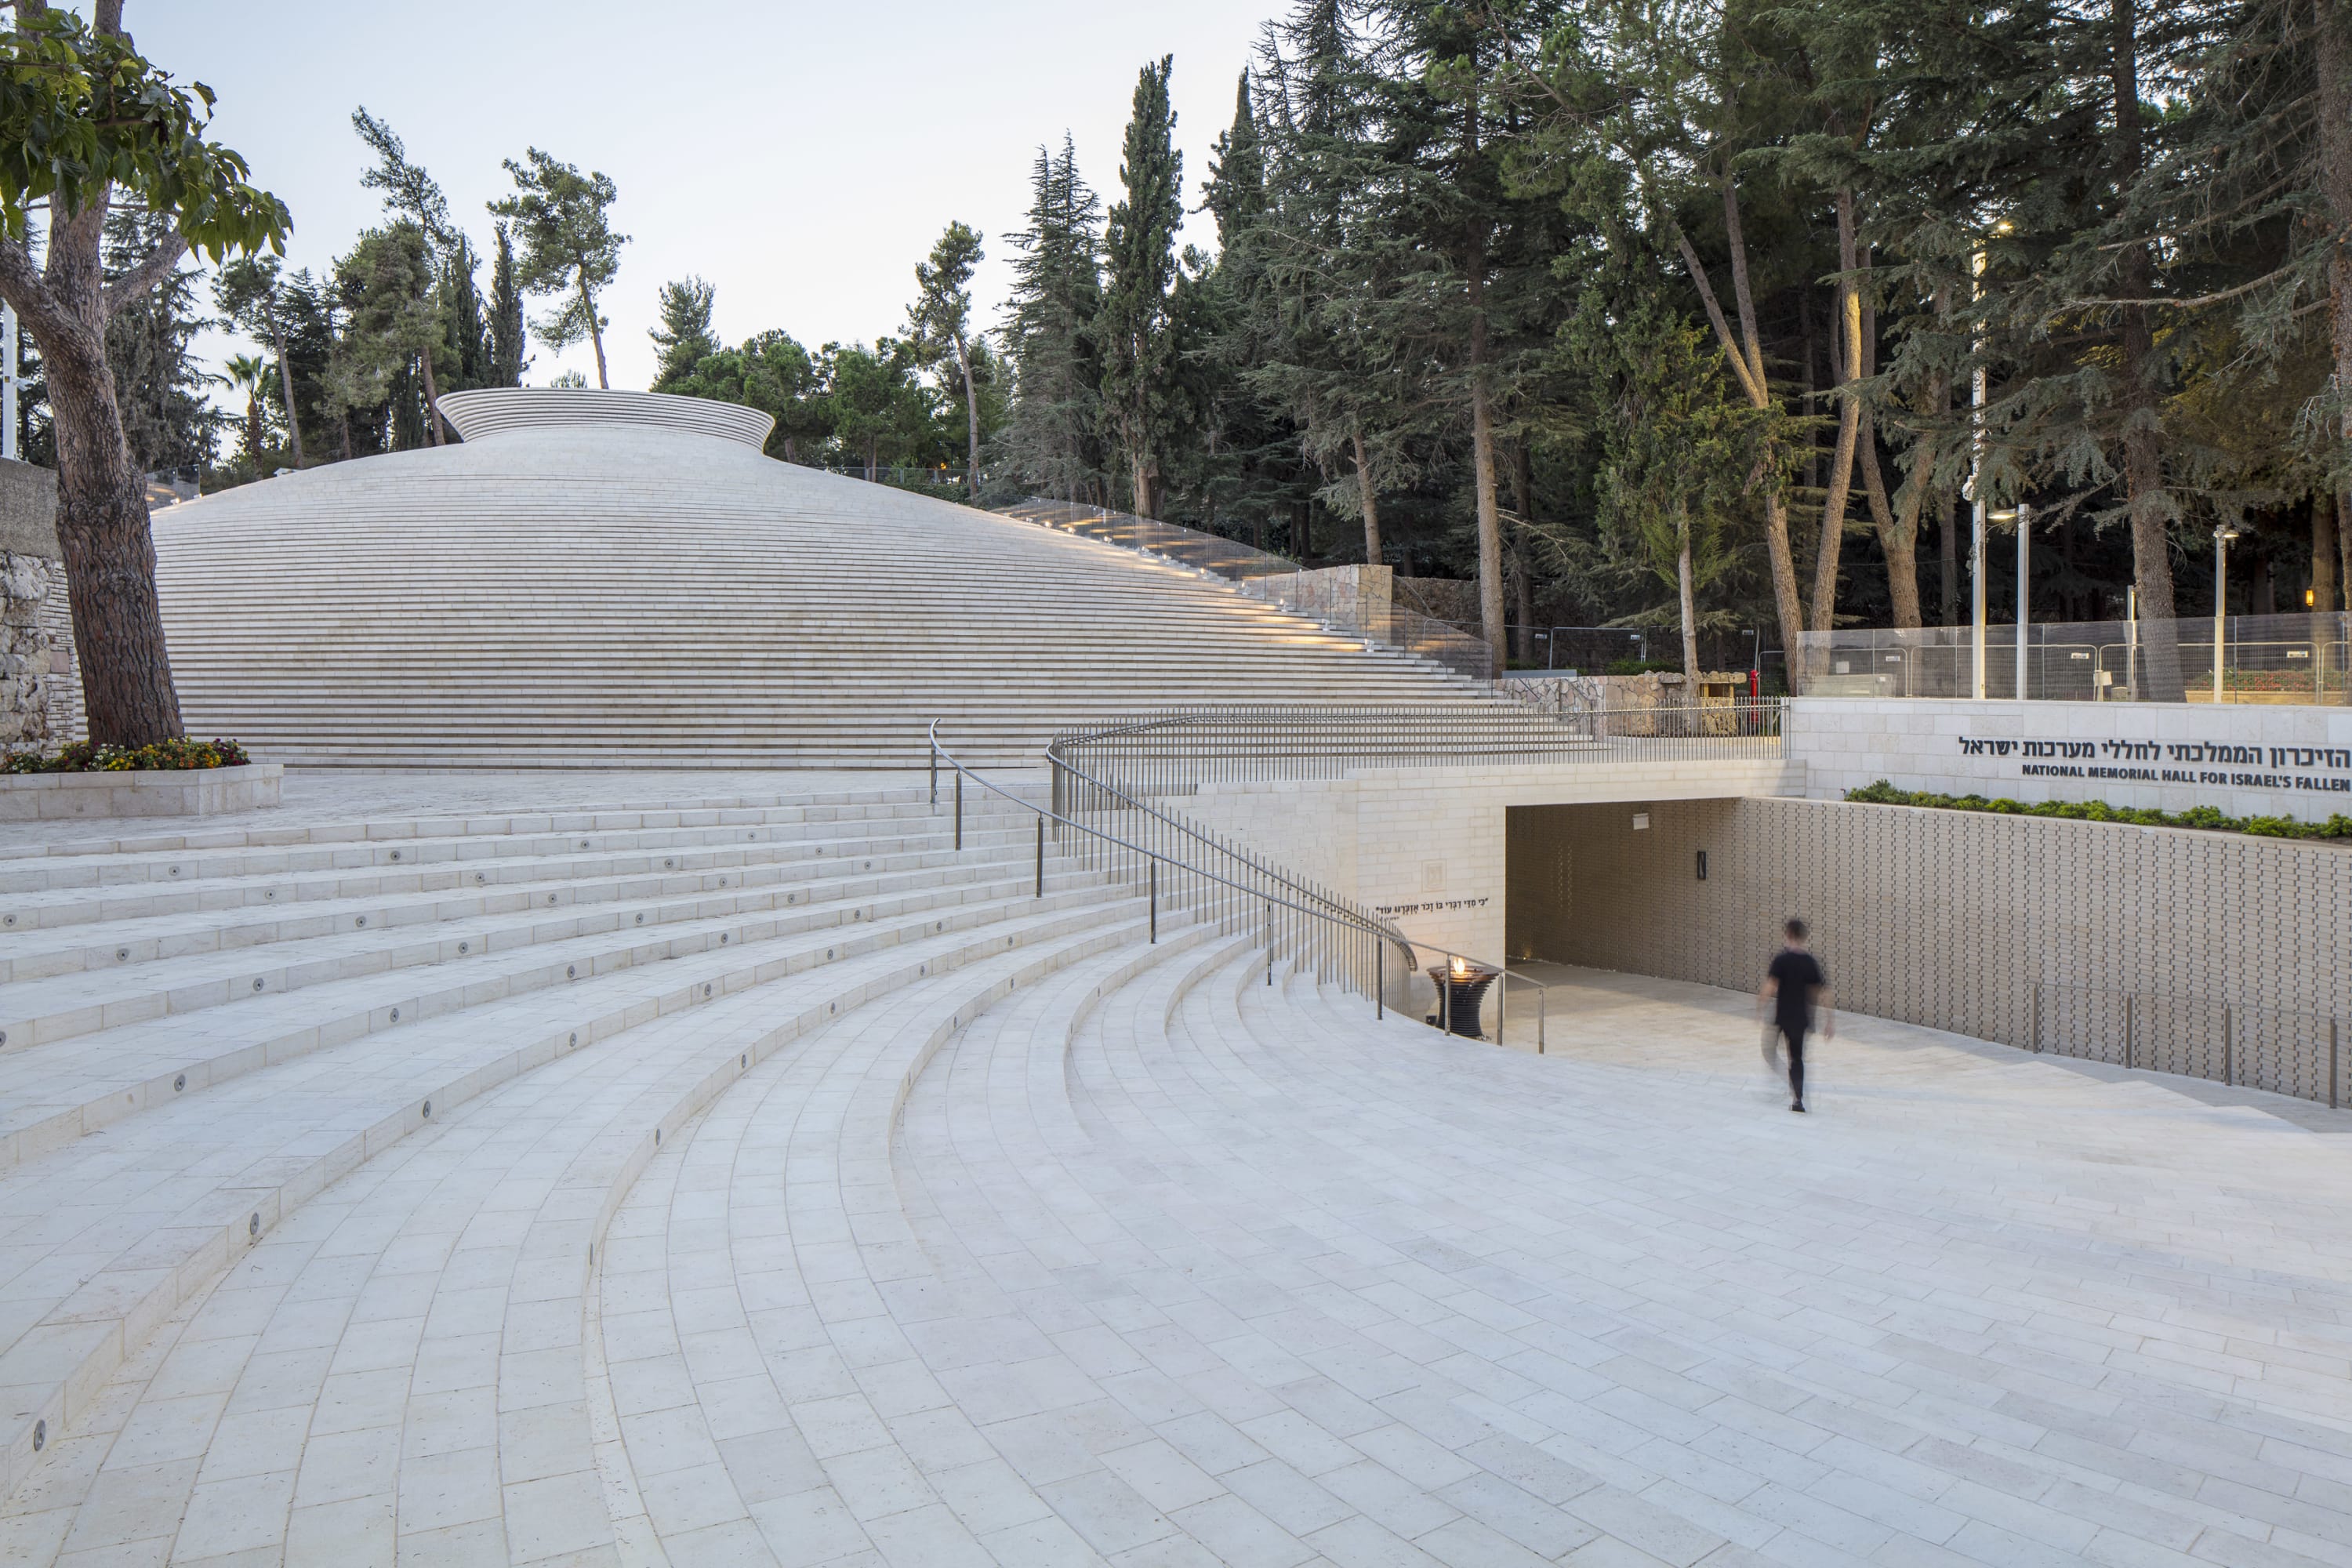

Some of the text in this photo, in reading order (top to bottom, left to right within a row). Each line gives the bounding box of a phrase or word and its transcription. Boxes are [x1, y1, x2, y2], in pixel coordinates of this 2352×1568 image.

[1958, 735, 2351, 769] הזיכרון הממלכתי לחללי מערכות ישראל
[2021, 764, 2352, 793] NATIONAL MEMORIAL HALL FOR ISRAEL'S FALLEN
